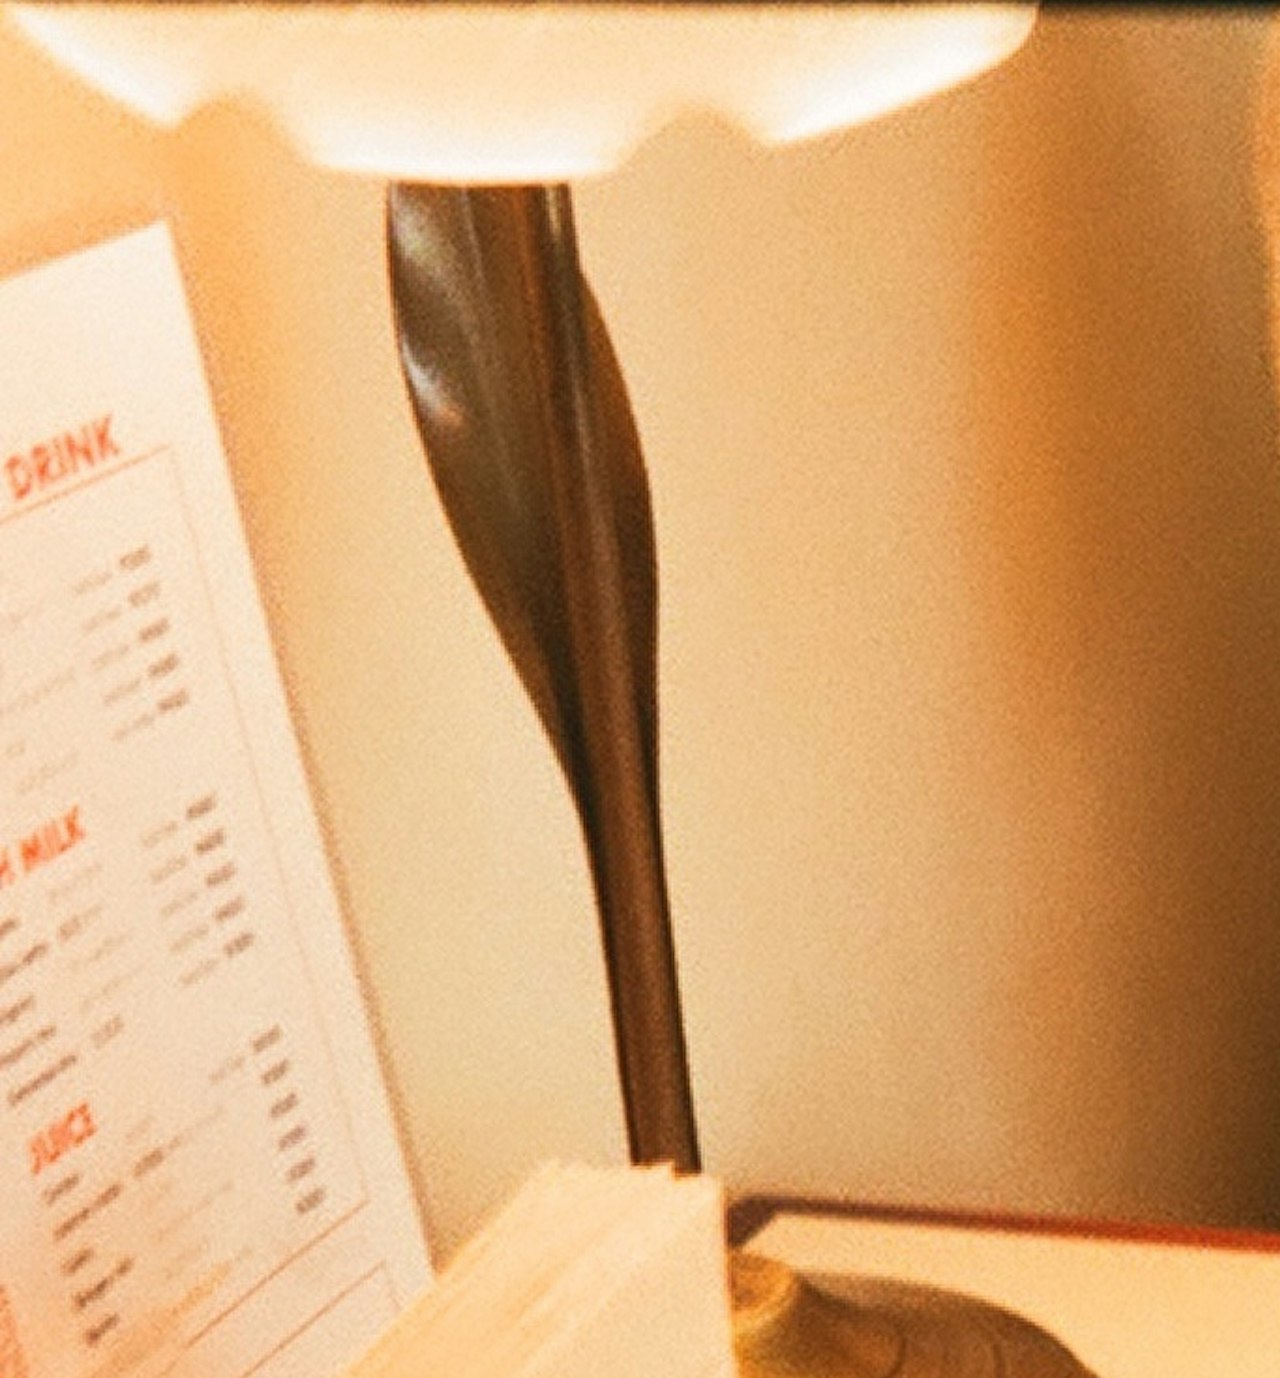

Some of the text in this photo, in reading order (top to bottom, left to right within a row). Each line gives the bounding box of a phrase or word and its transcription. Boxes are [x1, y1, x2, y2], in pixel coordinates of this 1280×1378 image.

[4, 412, 121, 500] DRINK
[19, 805, 86, 874] MILK
[29, 1102, 97, 1175] JUICE
